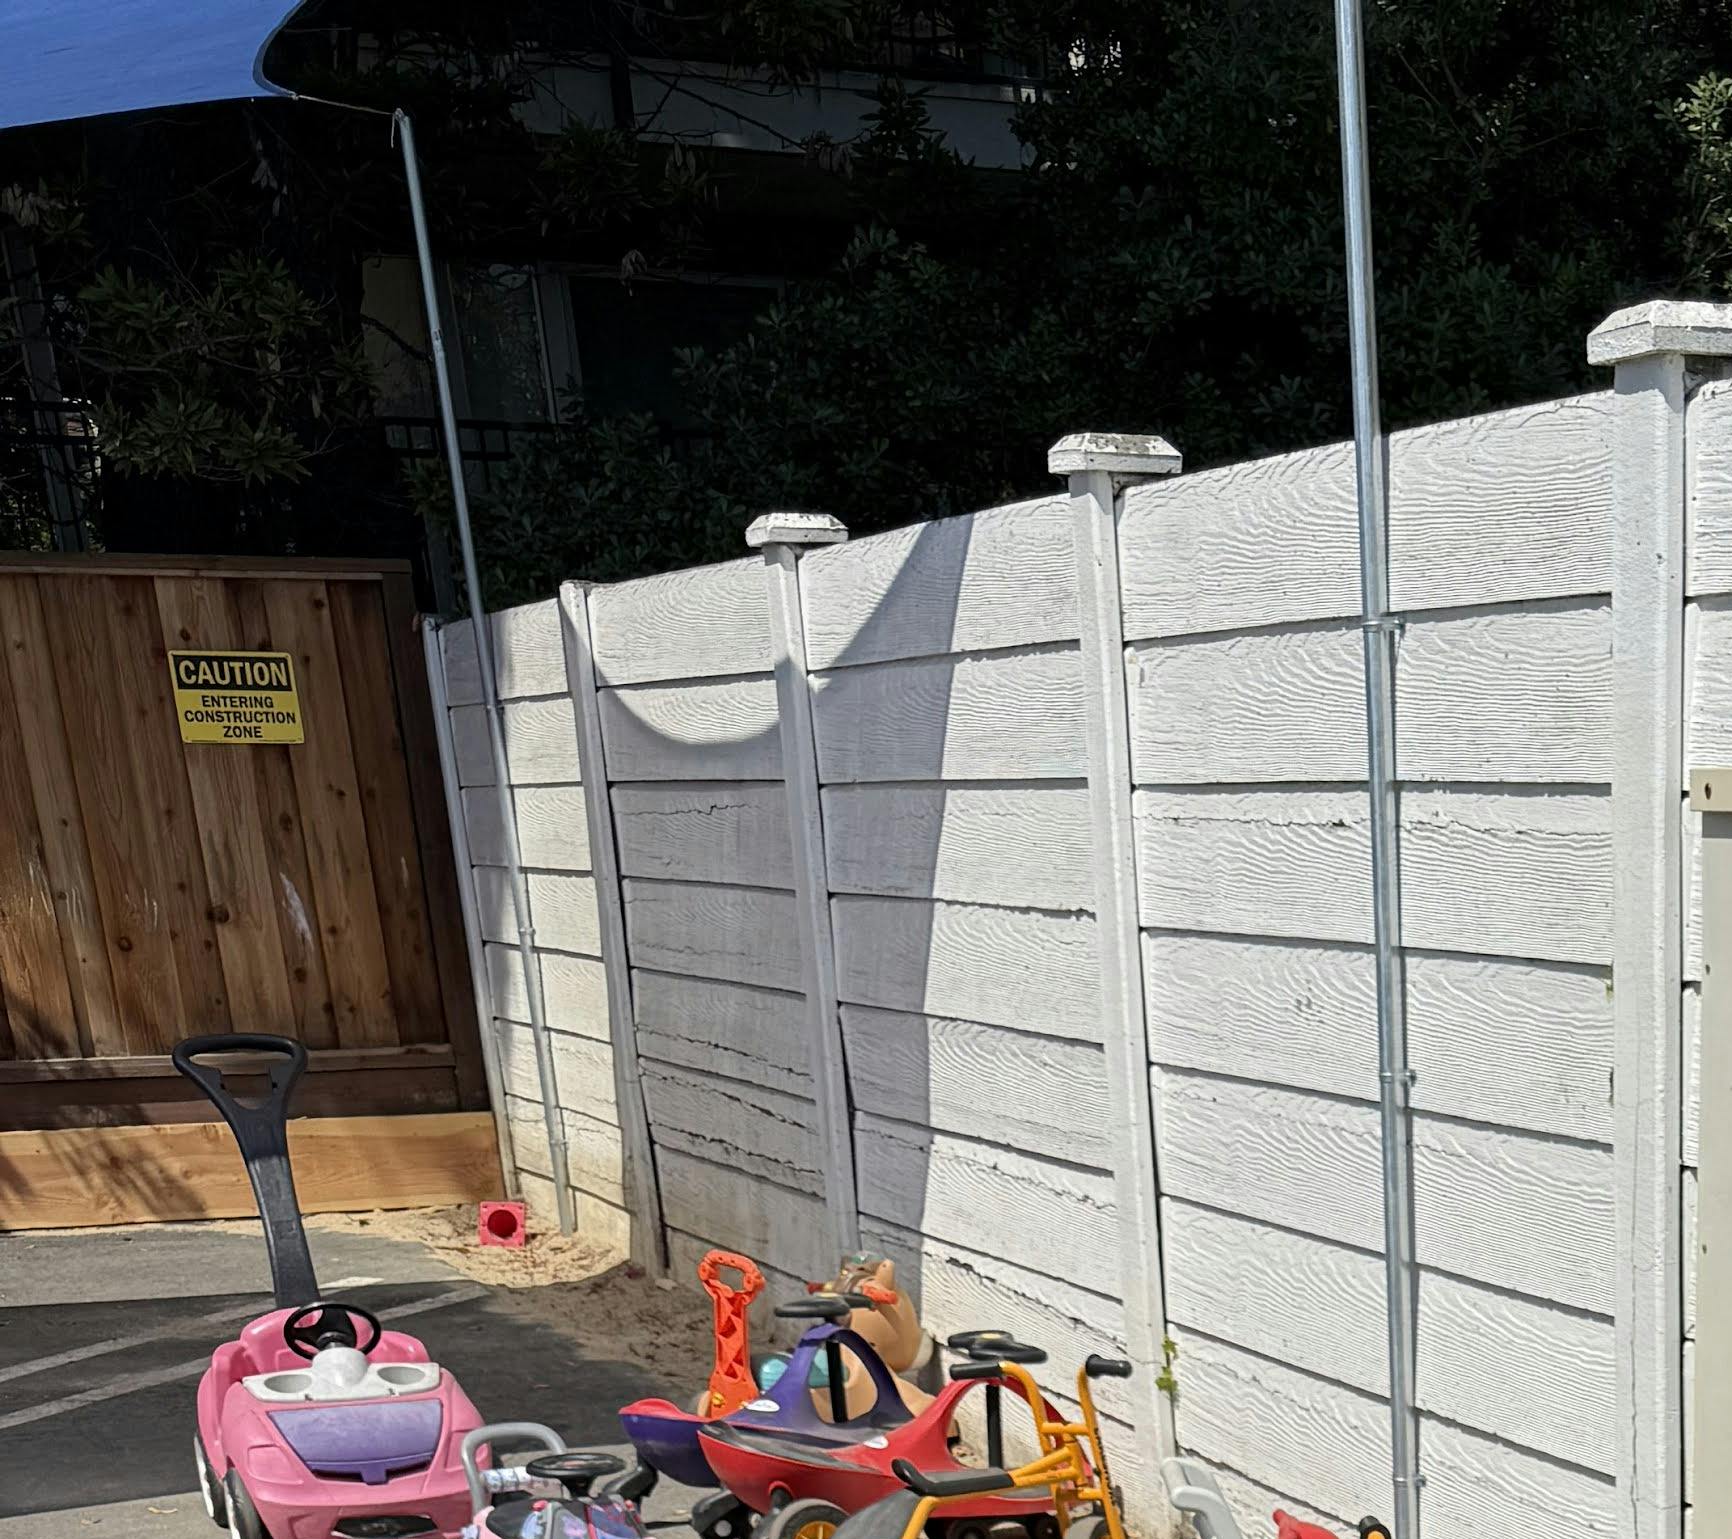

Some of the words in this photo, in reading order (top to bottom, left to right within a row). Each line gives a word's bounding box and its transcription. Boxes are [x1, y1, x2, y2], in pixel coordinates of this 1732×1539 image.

[179, 660, 288, 687] CAUTION
[201, 695, 274, 709] ENTERING
[184, 710, 296, 724] CONSTRUCTION
[223, 726, 263, 738] ZONE
